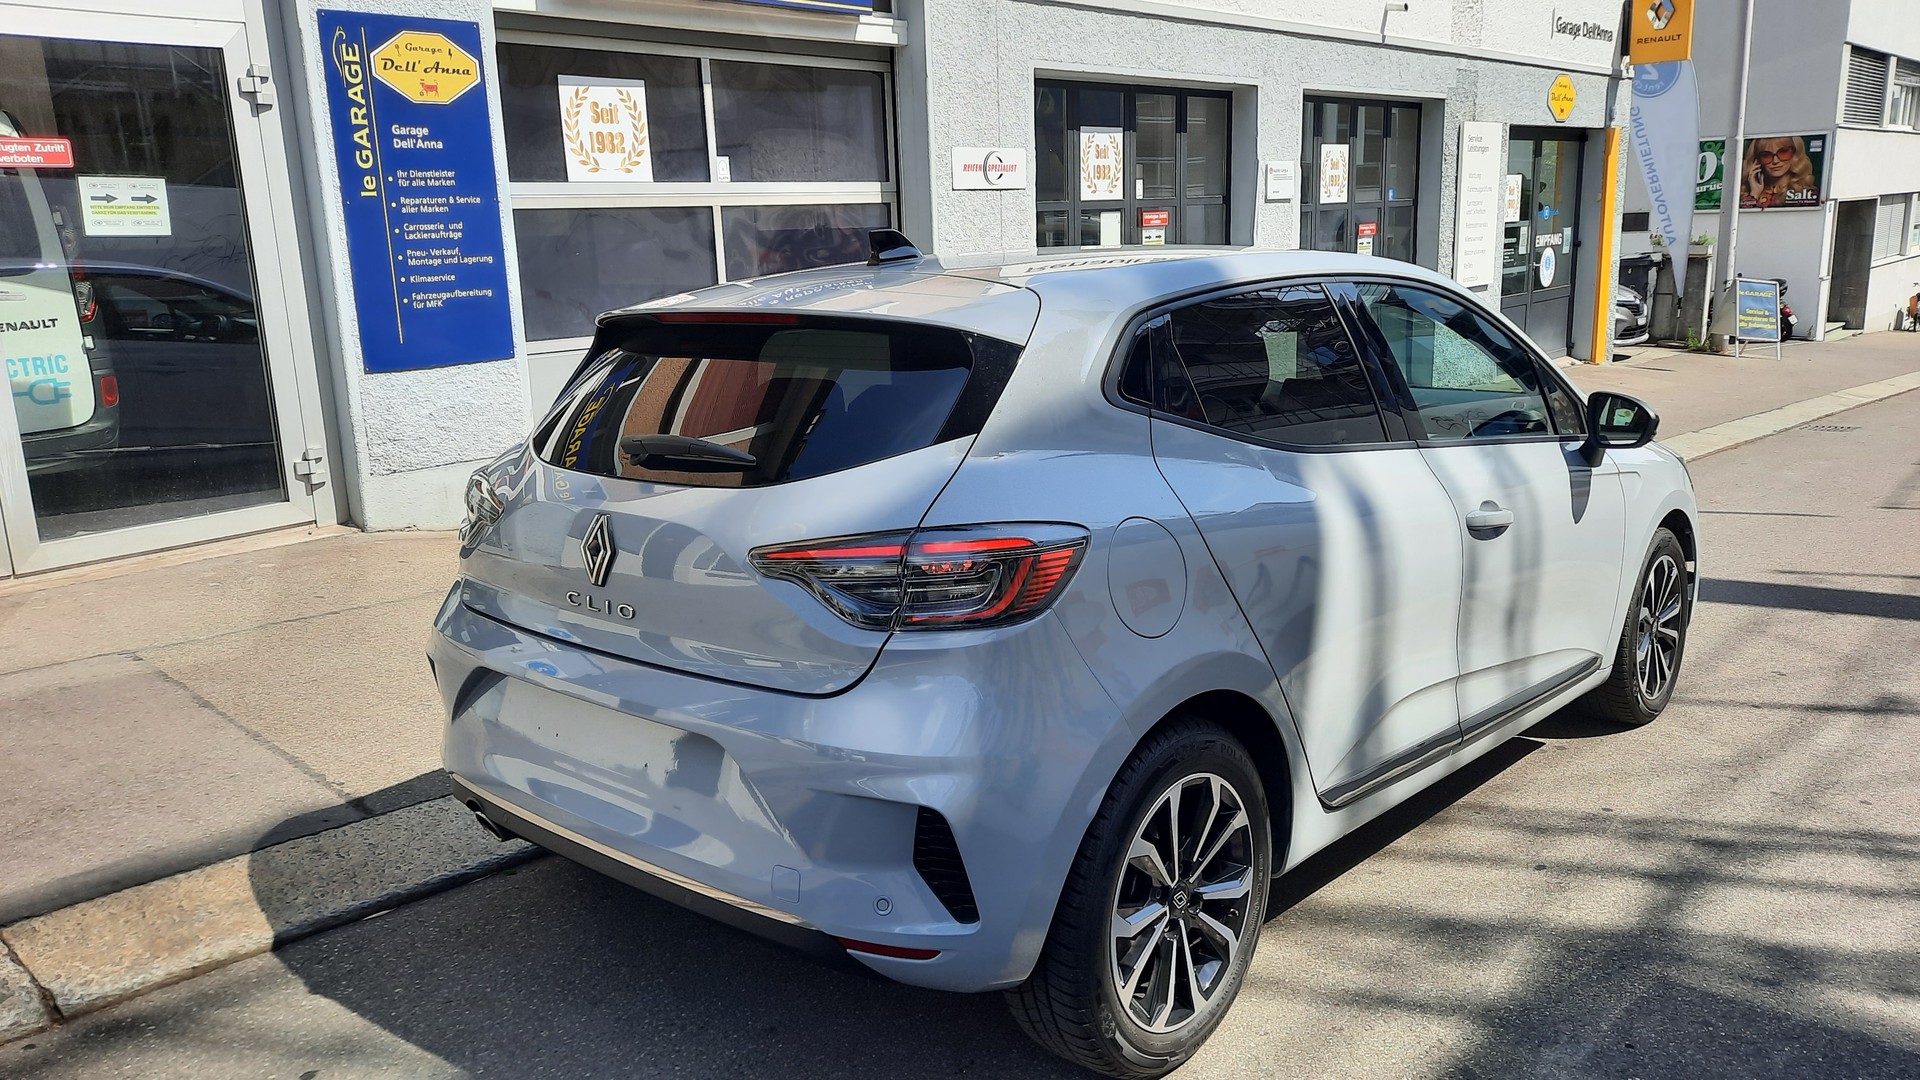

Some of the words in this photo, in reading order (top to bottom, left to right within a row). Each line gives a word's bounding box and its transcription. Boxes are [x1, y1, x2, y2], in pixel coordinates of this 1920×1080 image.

[1556, 16, 1581, 40] Garage
[1636, 34, 1682, 45] RENAULT
[404, 42, 443, 54] Garage
[381, 57, 421, 73] Dell'
[424, 61, 472, 77] Anna
[344, 43, 375, 169] GARAGE
[590, 101, 620, 124] Seit
[392, 125, 429, 136] Garage
[393, 138, 444, 149] Dell'Anna
[589, 132, 626, 153] 1982
[1468, 134, 1483, 142] Service
[34, 143, 66, 153] Zutritt
[1094, 144, 1110, 160] Seit
[1467, 144, 1490, 154] Leistungen
[0, 154, 44, 163] verboten
[963, 164, 982, 172] REIFEN
[988, 164, 1017, 172] SPEZIALIST
[1093, 164, 1111, 180] 1982
[397, 170, 408, 178] Ihr
[410, 170, 456, 178] Dienstleister
[361, 175, 378, 198] le
[398, 178, 410, 187] für
[412, 178, 426, 187] alle
[427, 178, 456, 186] Marken
[1696, 183, 1723, 192] urüc
[1786, 188, 1818, 200] Salt.
[400, 196, 448, 206] Reparaturen
[449, 196, 455, 204] &
[456, 196, 481, 204] Service
[402, 205, 418, 214] aller
[420, 205, 449, 213] Marken
[404, 222, 445, 231] Carrosserie
[448, 222, 463, 230] und
[404, 231, 463, 240] Lackieraufträge
[1535, 233, 1563, 248] EMPFANG
[407, 249, 428, 257] Pneu-
[430, 247, 462, 256] Verkauf,
[408, 256, 442, 266] Montage
[444, 256, 458, 264] und
[460, 255, 493, 264] Lagerung
[410, 274, 456, 283] Klimaservice
[412, 288, 492, 300] Fahrzeugaufbereitung
[413, 301, 426, 309] für
[426, 300, 443, 308] MFK
[566, 590, 635, 620] CLIO
